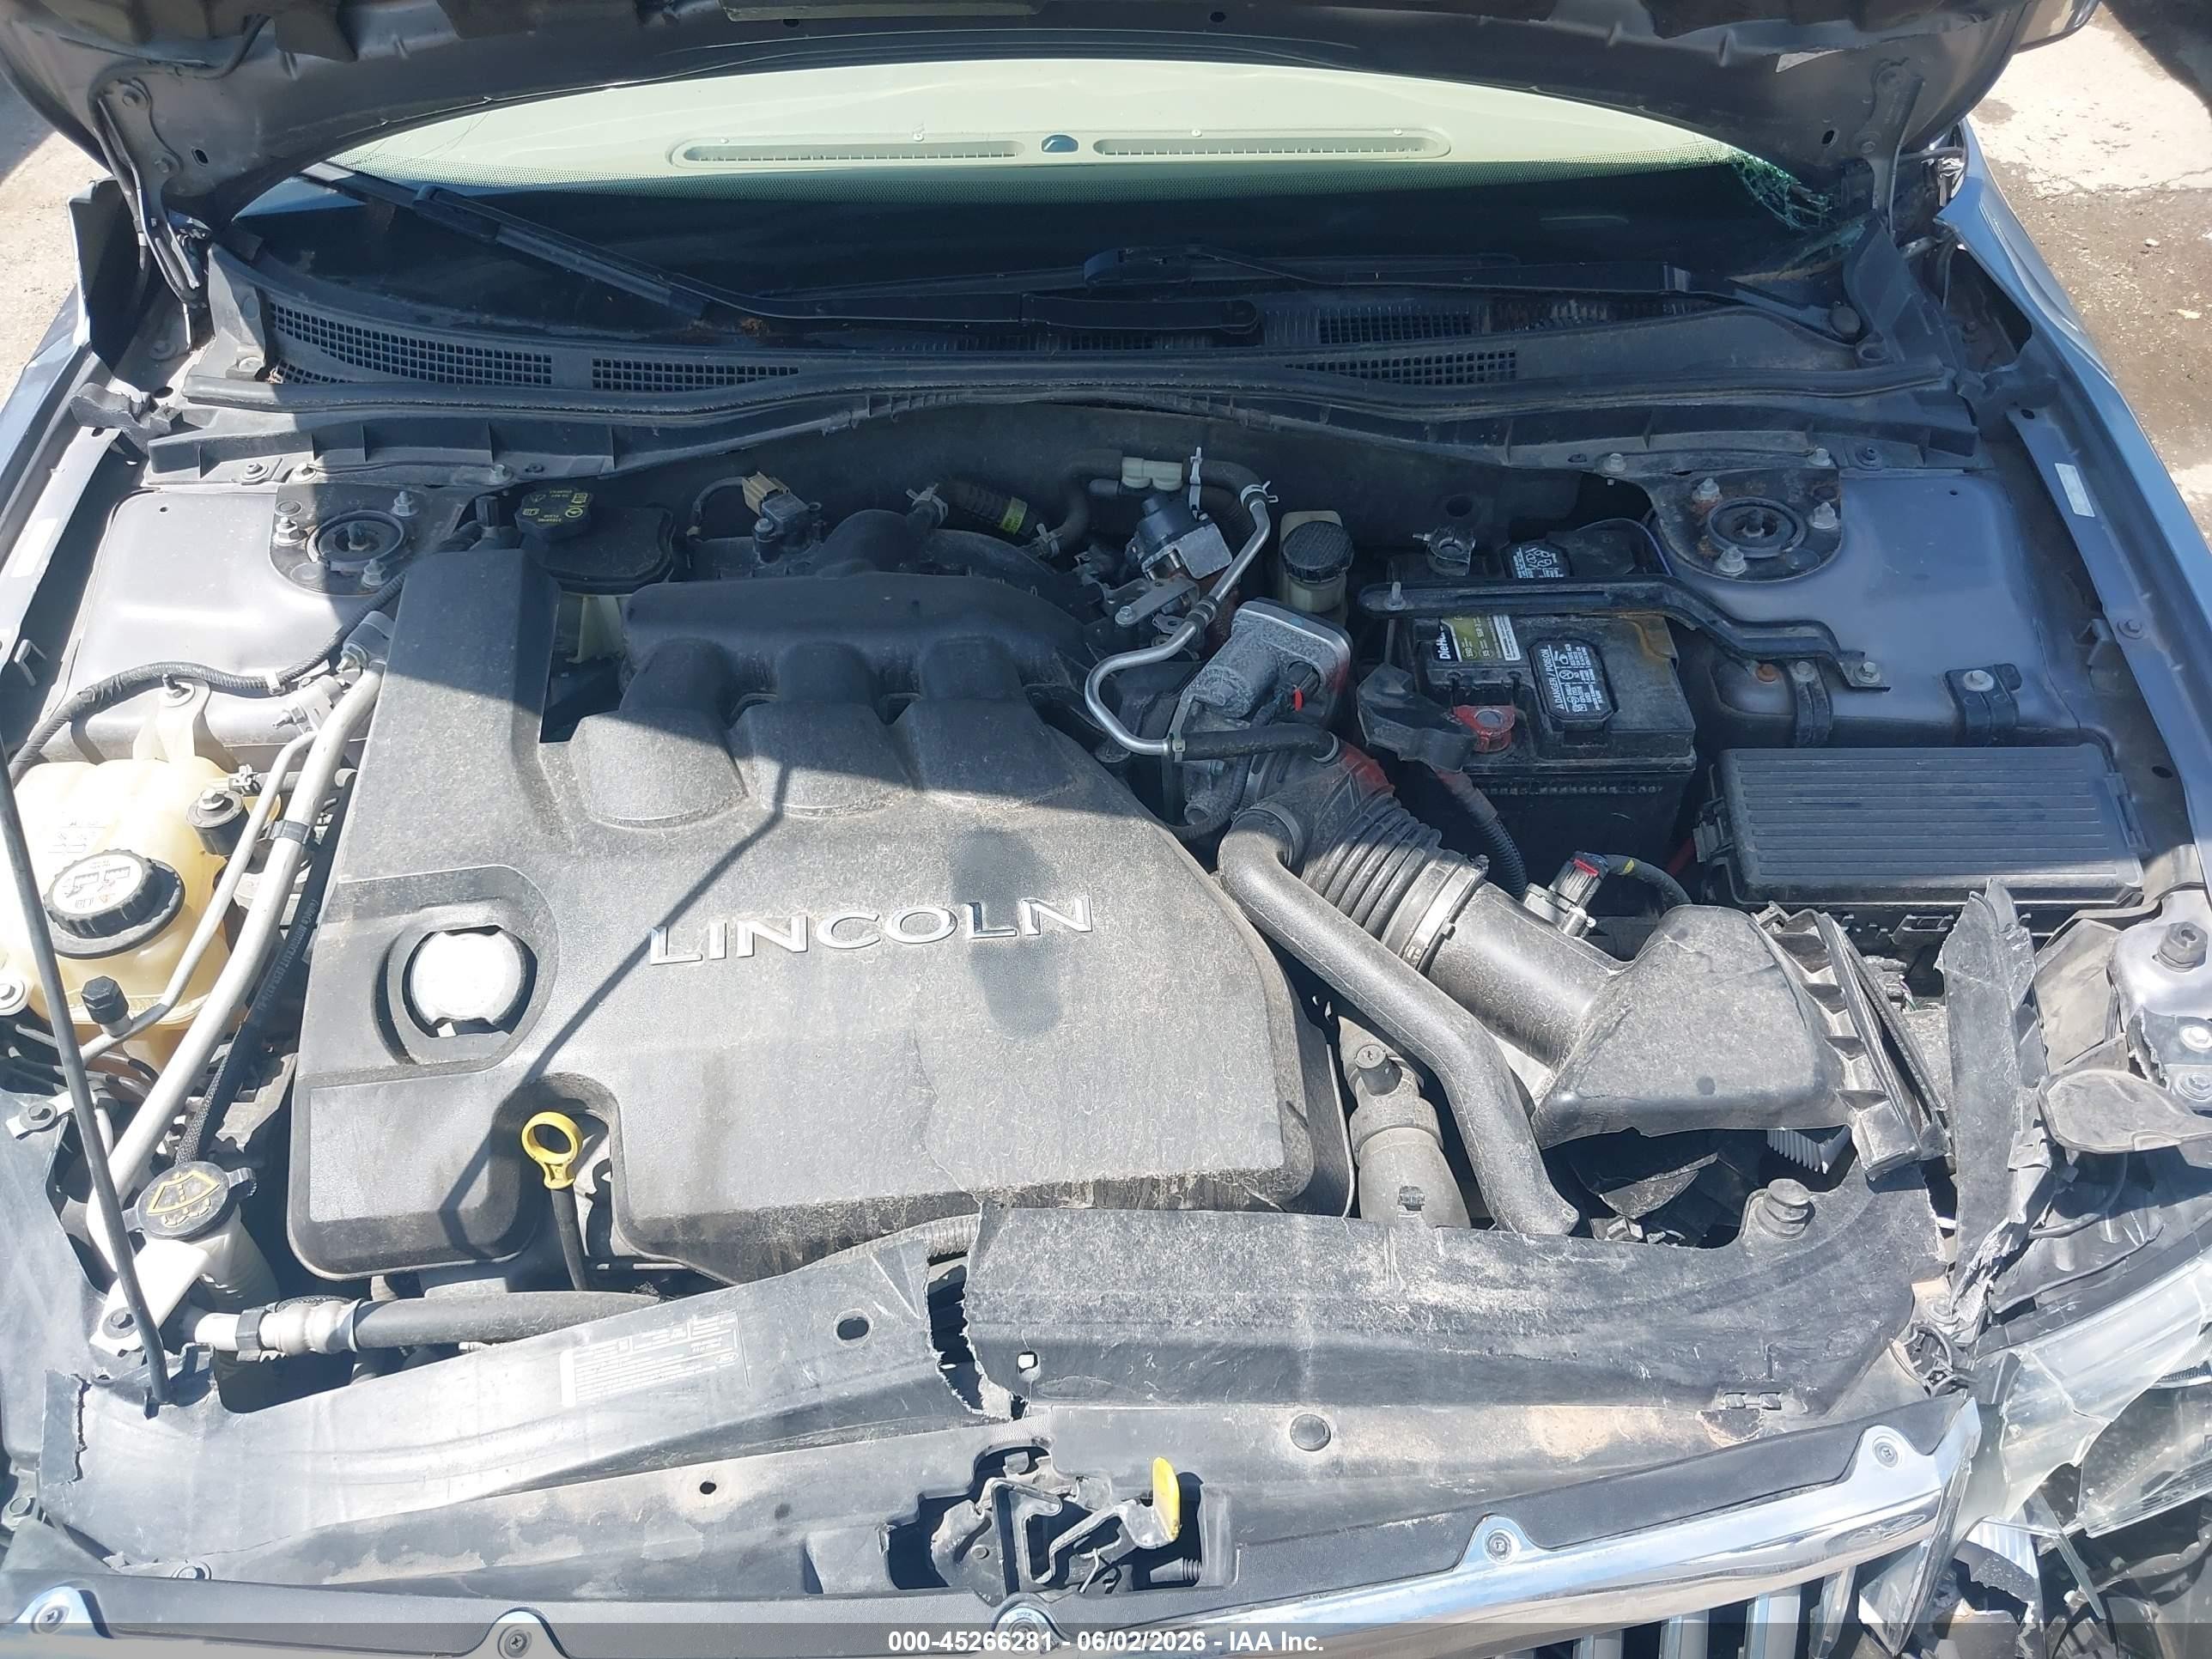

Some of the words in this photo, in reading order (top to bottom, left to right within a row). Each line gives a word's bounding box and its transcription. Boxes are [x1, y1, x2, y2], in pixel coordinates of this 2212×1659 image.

[1436, 625, 1451, 659] DieH
[1540, 648, 1552, 672] POISON
[1548, 677, 1561, 703] DANGER
[649, 896, 1093, 965] LINCOLN
